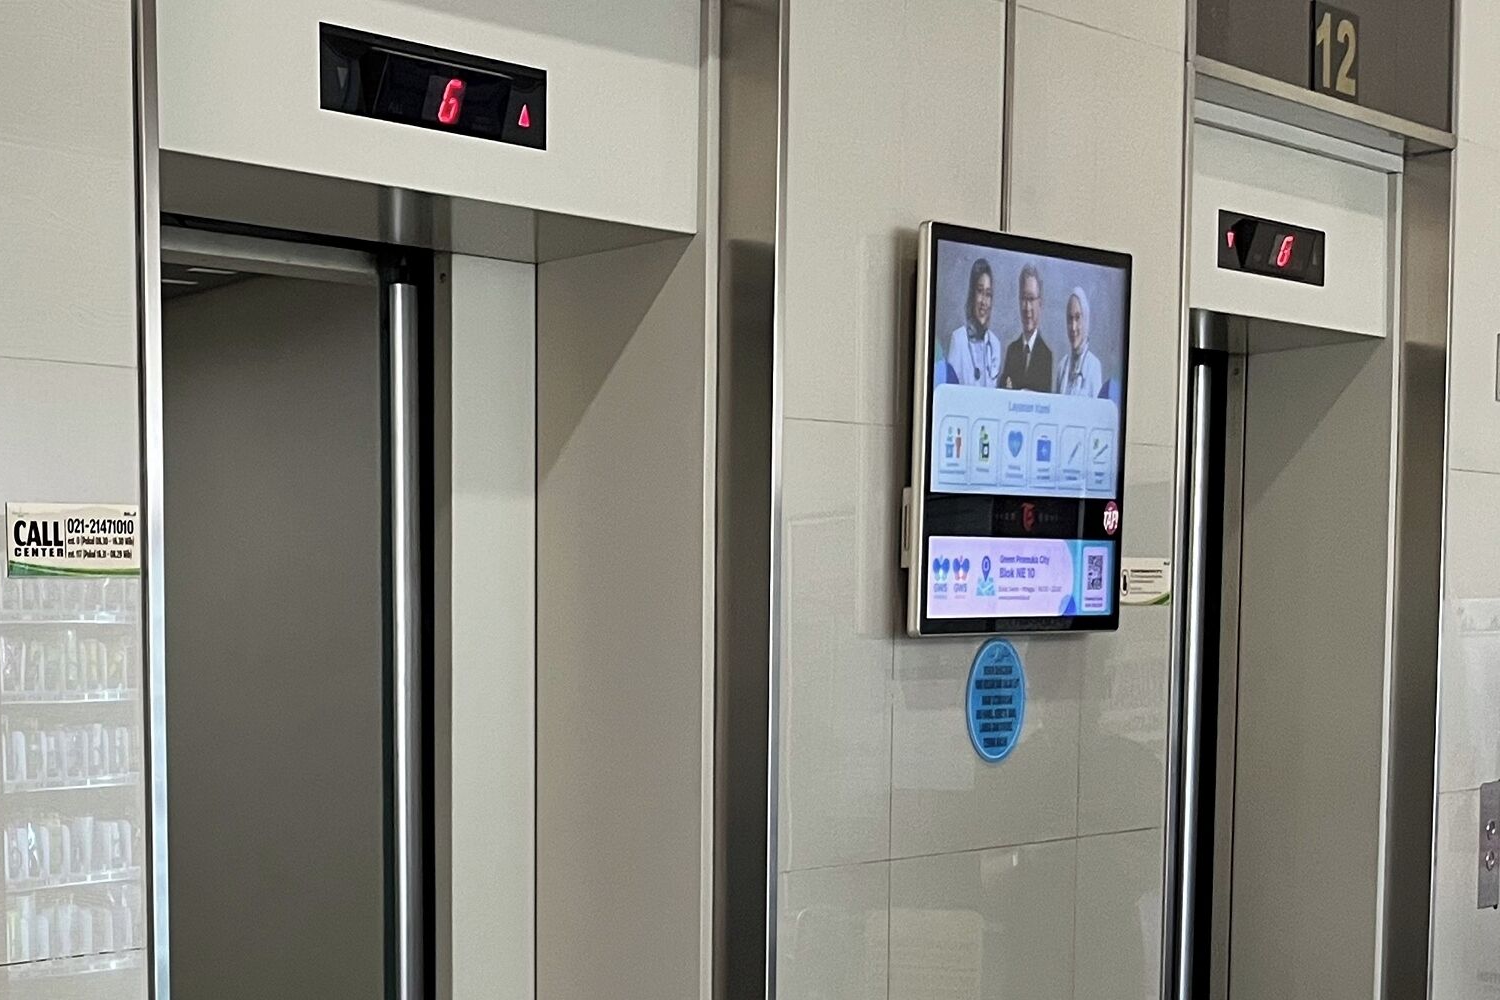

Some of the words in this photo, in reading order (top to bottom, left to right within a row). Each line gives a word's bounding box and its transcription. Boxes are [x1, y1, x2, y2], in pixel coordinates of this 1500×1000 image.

[1315, 12, 1356, 97] 12
[437, 78, 464, 125] 6
[1276, 235, 1295, 267] 6
[13, 520, 64, 547] CALL
[67, 518, 134, 534] 021-21471010
[14, 547, 64, 557] CENTER
